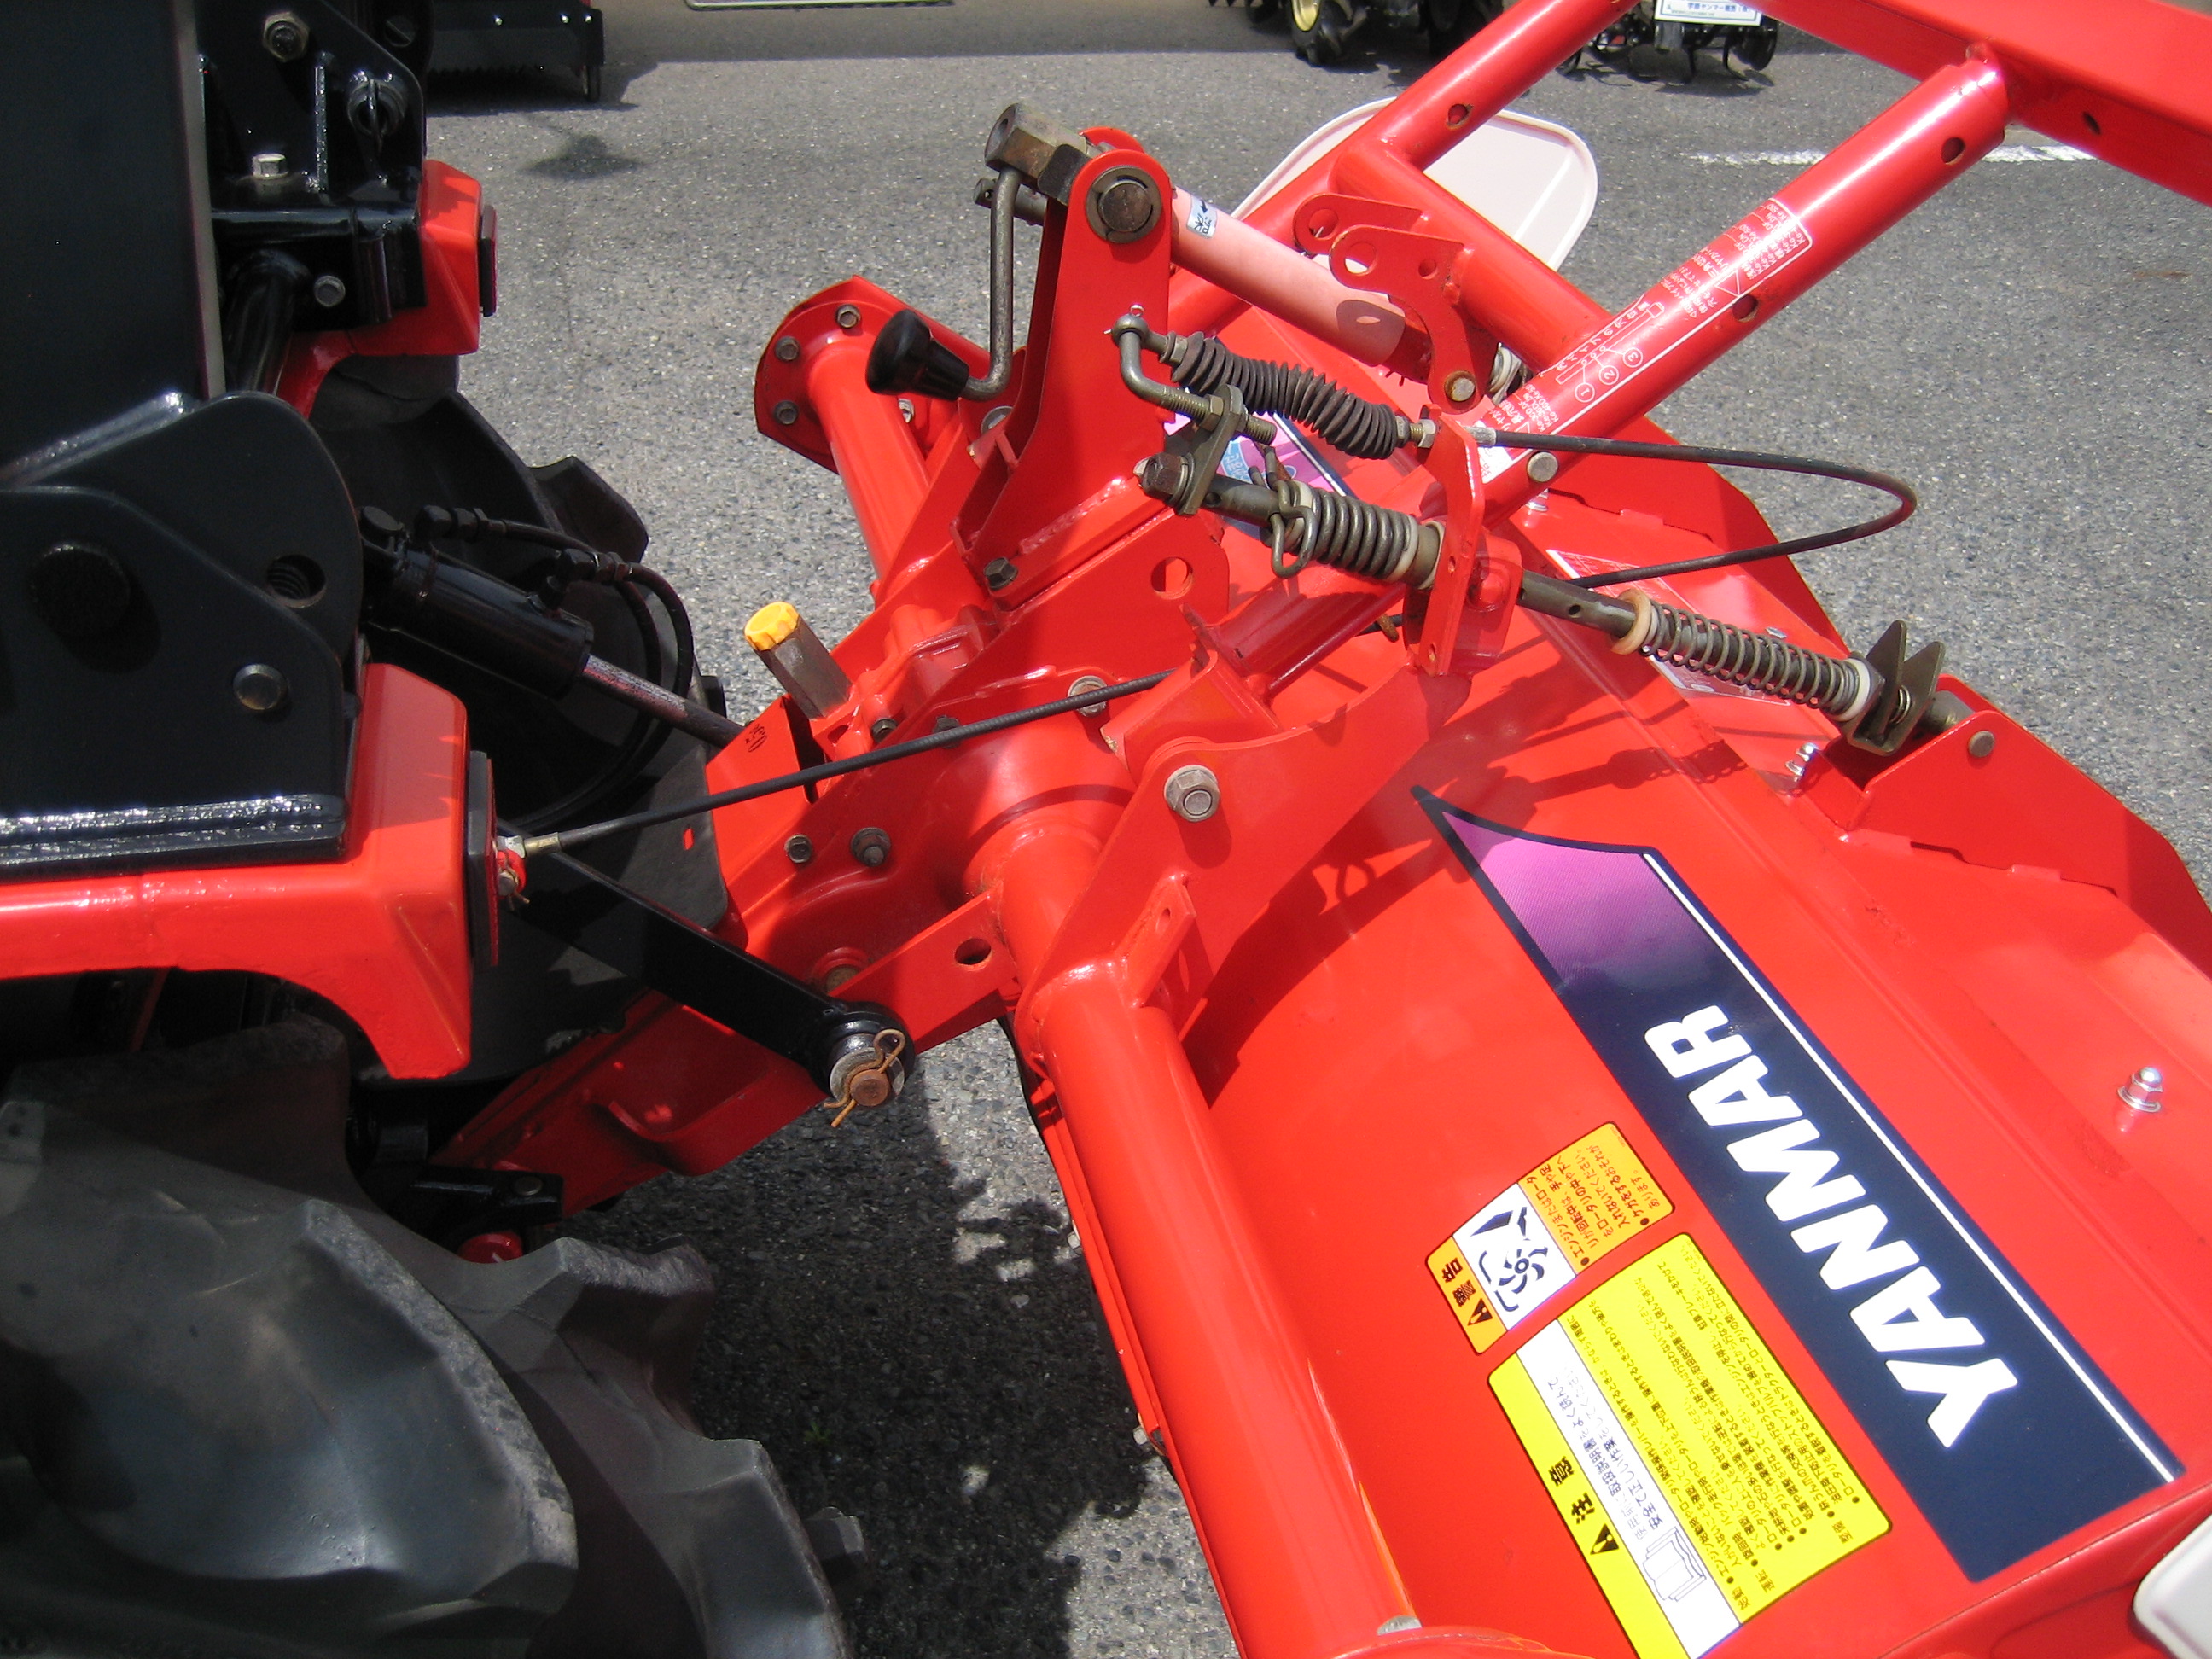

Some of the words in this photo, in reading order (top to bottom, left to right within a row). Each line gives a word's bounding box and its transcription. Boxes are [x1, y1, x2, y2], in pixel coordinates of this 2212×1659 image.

[1644, 1004, 2019, 1448] YANMAR
[1439, 1255, 1477, 1307] 警告
[1545, 1453, 1598, 1524] 注意
